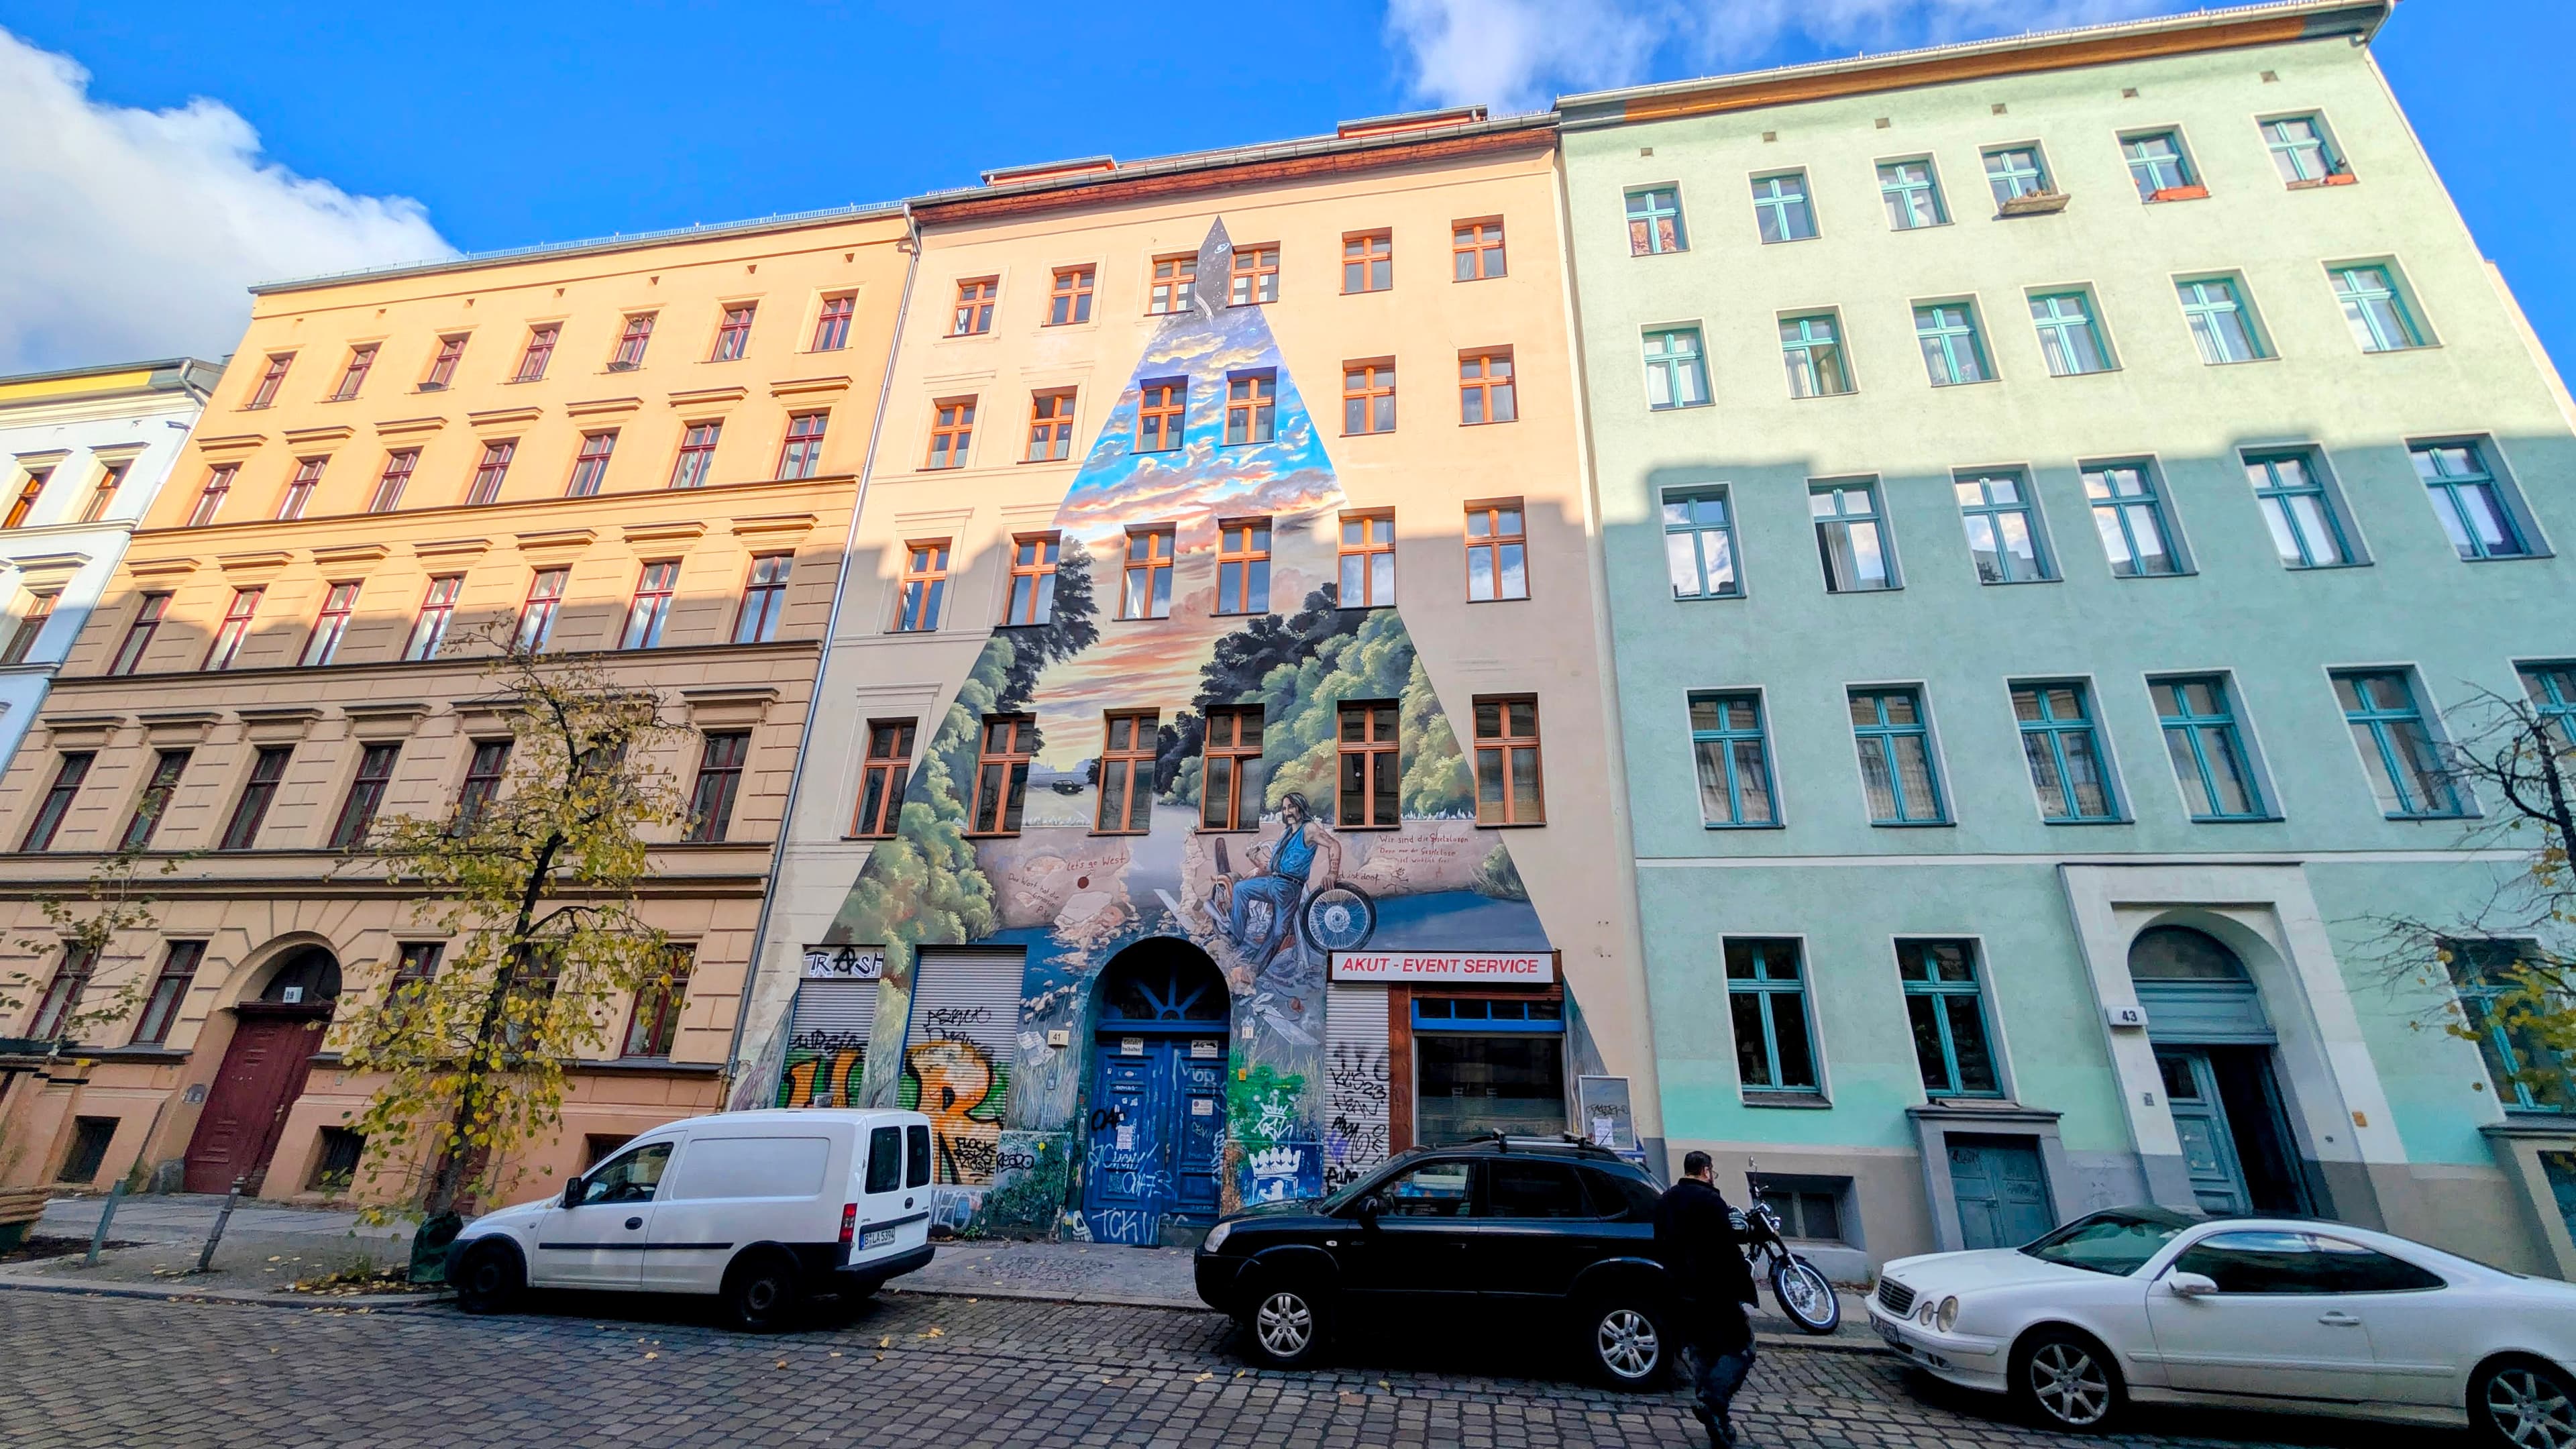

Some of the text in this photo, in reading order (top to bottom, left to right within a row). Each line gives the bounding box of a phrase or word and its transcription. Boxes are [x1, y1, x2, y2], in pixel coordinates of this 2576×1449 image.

[1379, 835, 1394, 843] Wir
[1398, 835, 1413, 843] sind
[1067, 852, 1126, 871] Let's go West
[1347, 871, 1359, 880] ist
[1361, 870, 1381, 884] doof
[1021, 876, 1038, 888] Wort
[1040, 885, 1051, 895] hat
[1049, 891, 1060, 901] die
[1342, 957, 1390, 972] AKUT
[1402, 958, 1461, 973] EVENT
[1463, 959, 1539, 974] SERVICE
[285, 991, 294, 1000] 39
[2122, 1010, 2137, 1022] 43
[1053, 1033, 1061, 1041] 41
[872, 1232, 880, 1244] LA
[881, 1228, 895, 1242] 5394
